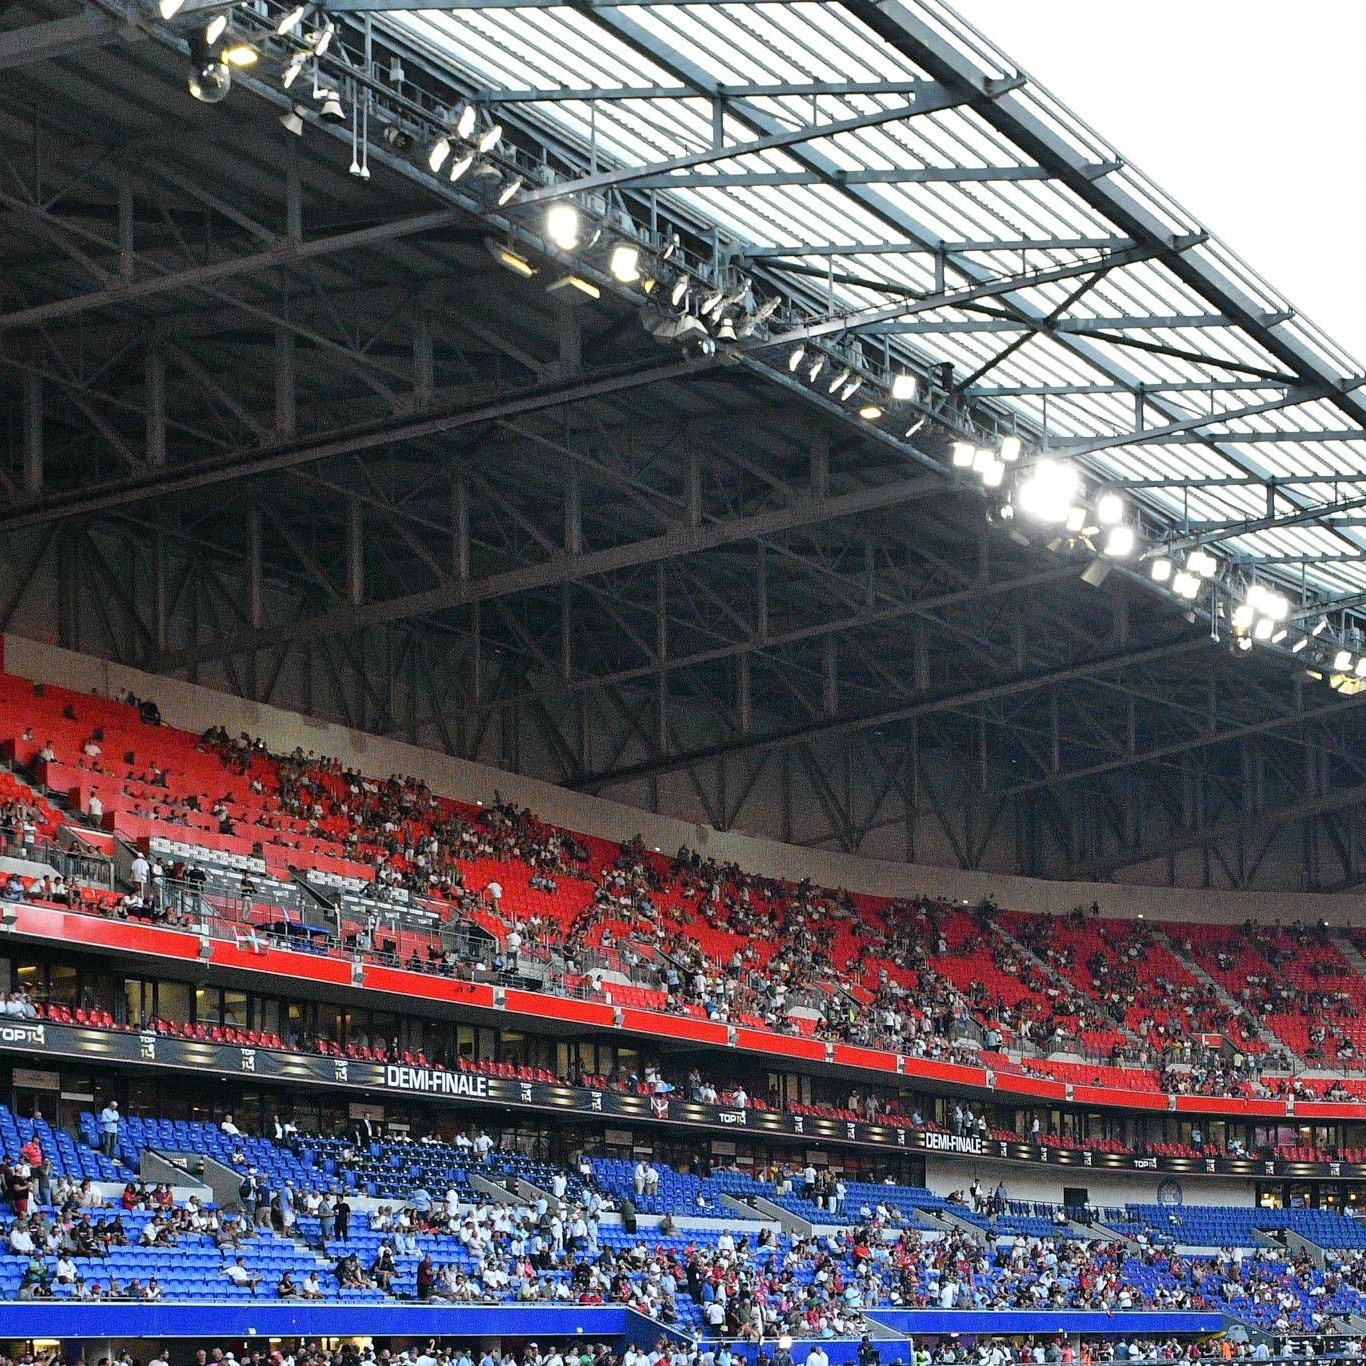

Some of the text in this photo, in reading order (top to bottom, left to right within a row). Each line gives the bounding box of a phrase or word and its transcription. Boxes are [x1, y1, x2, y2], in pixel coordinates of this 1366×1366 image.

[139, 1035, 156, 1044] TOP
[241, 1048, 256, 1057] TOP
[386, 1065, 487, 1097] DEMI-FINALE
[925, 1132, 982, 1155] DEMI-FINALE
